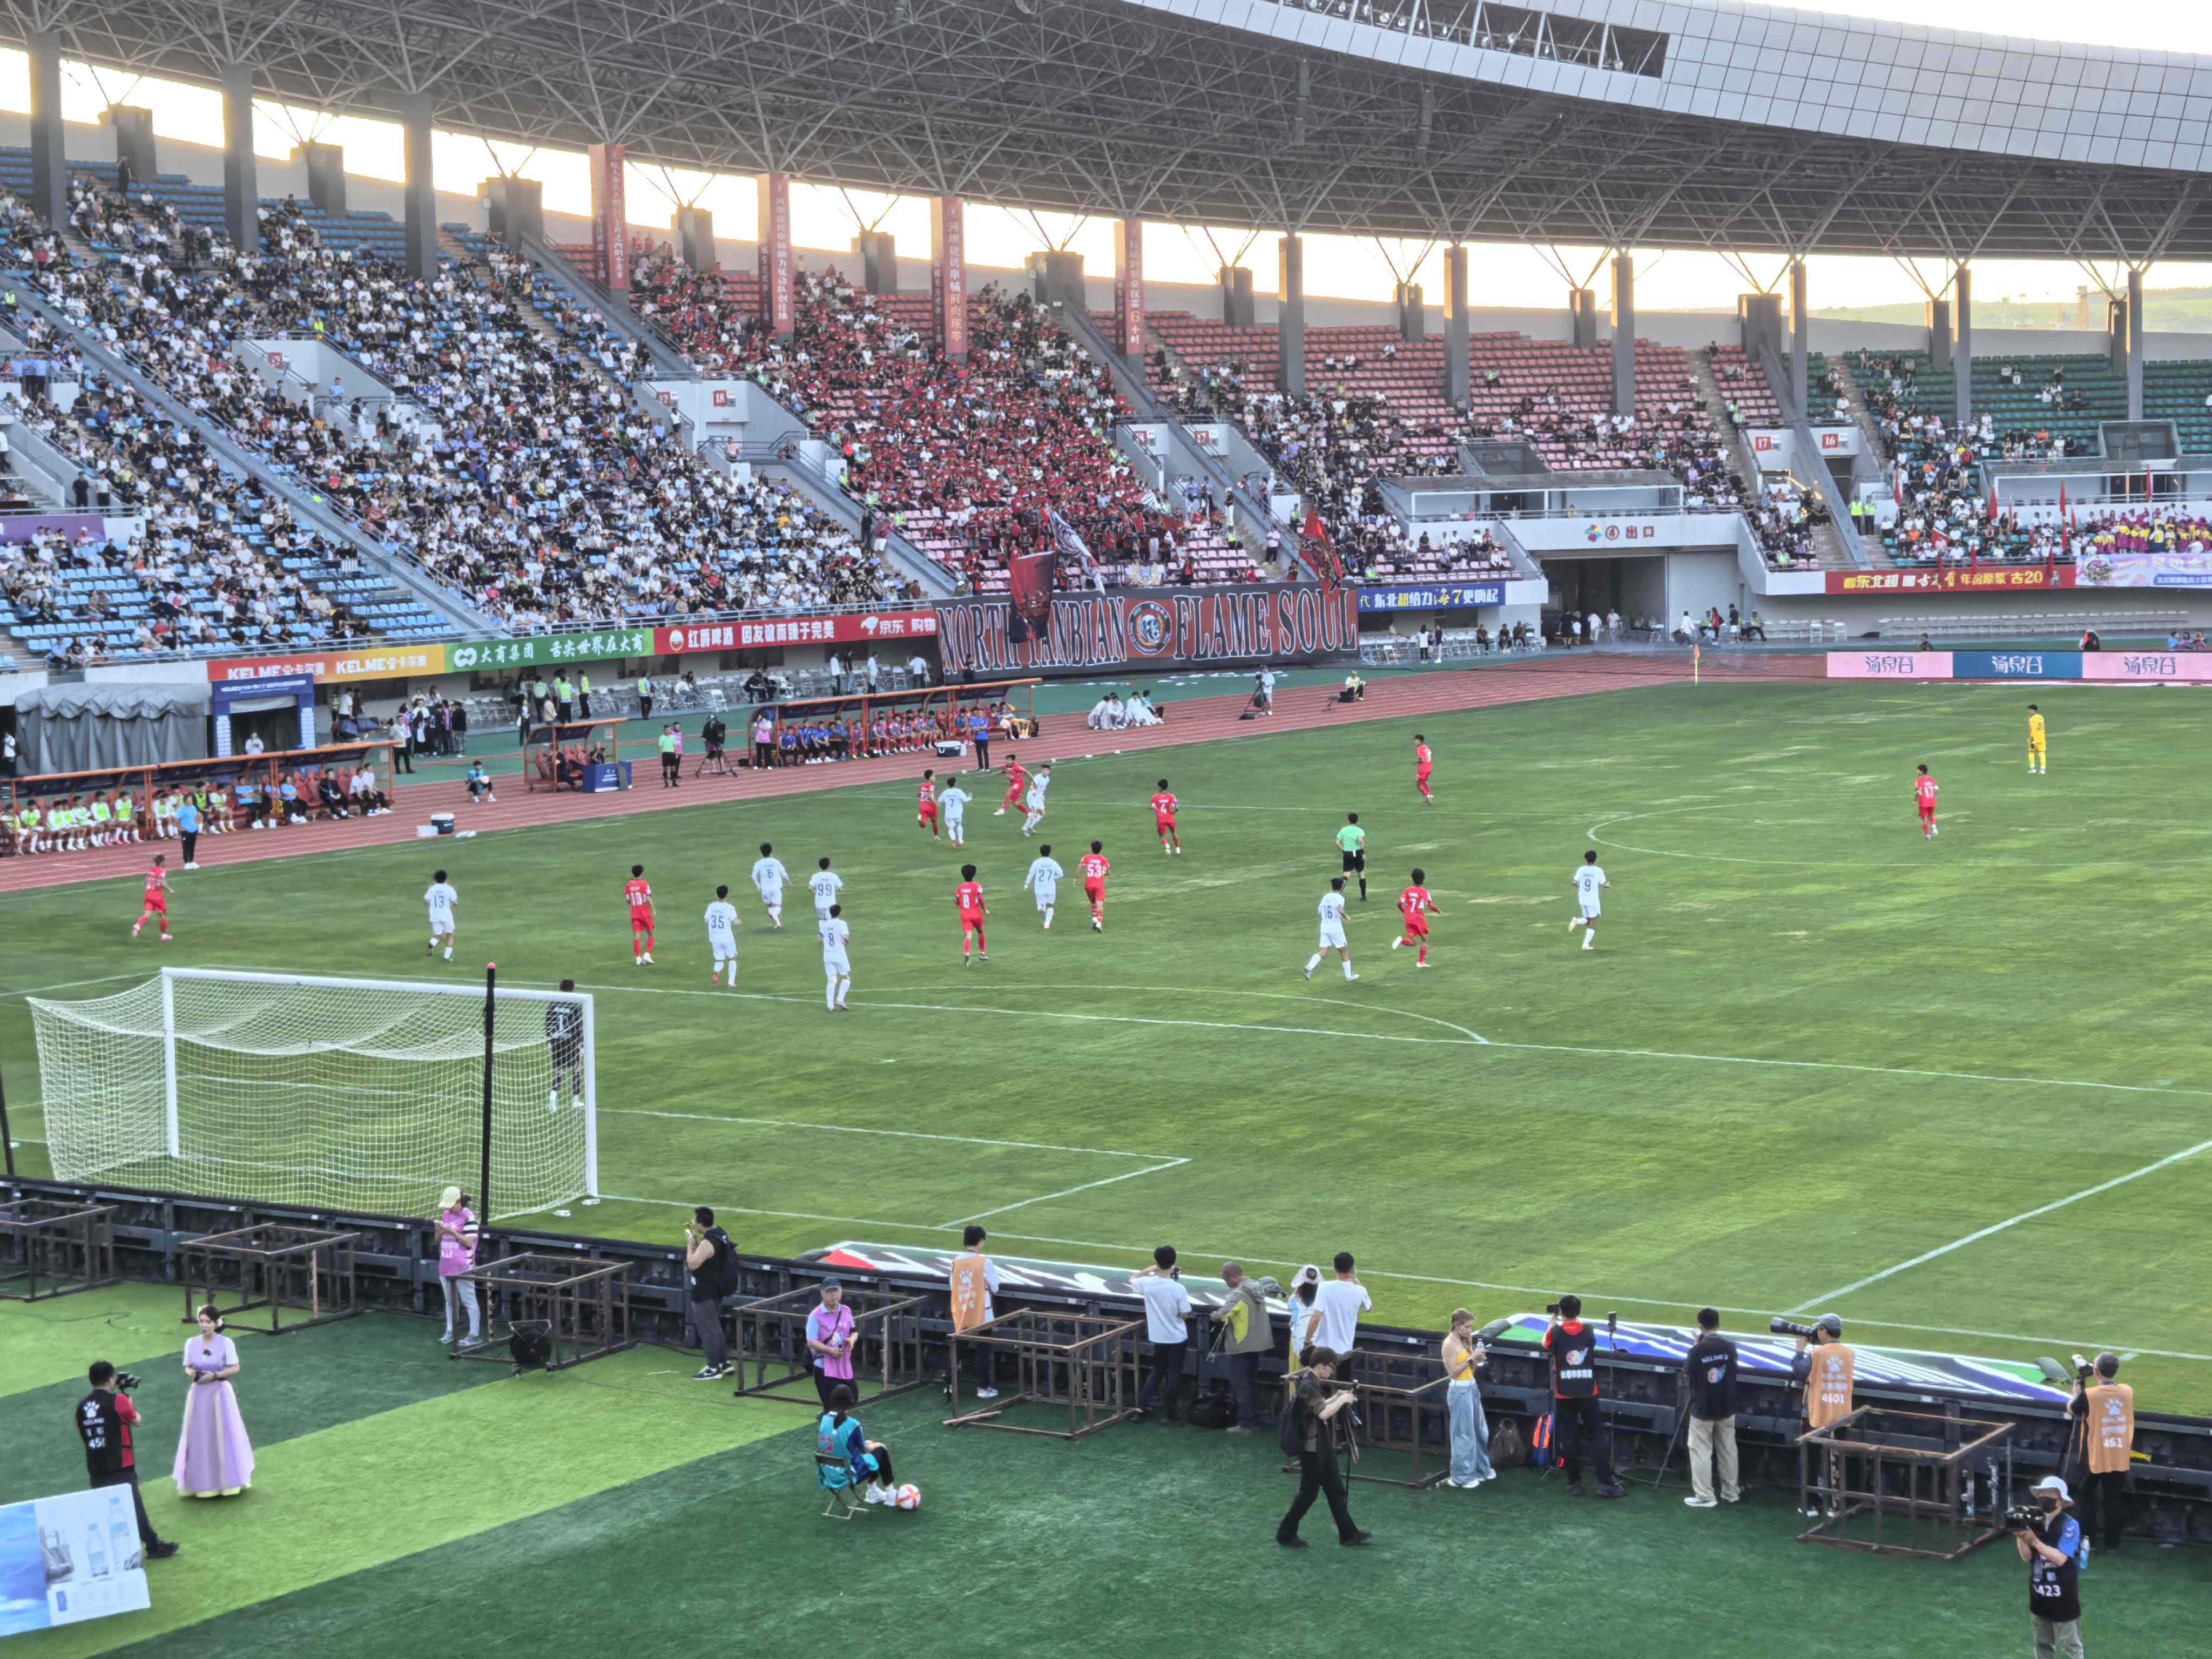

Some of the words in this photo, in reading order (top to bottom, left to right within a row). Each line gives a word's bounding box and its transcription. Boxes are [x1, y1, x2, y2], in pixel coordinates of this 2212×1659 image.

[1758, 438, 1768, 449] 17
[1825, 436, 1836, 446] 16
[1626, 525, 1654, 539] 出口
[879, 619, 905, 635] 京东
[911, 618, 936, 632] 购物
[1173, 592, 1273, 660] FLAME
[1278, 588, 1357, 655] SOUL
[481, 642, 534, 663] 大商集团
[550, 633, 643, 658] 舌尖世界在大商
[228, 664, 281, 680] KELME
[336, 657, 386, 675] KELME
[1038, 869, 1053, 882] 27
[817, 883, 832, 896] 99
[1584, 879, 1591, 892] 9
[434, 895, 444, 908] 13
[1410, 899, 1417, 913] 7
[1324, 905, 1333, 919] 16
[711, 915, 724, 929] 35
[828, 933, 834, 947] 8
